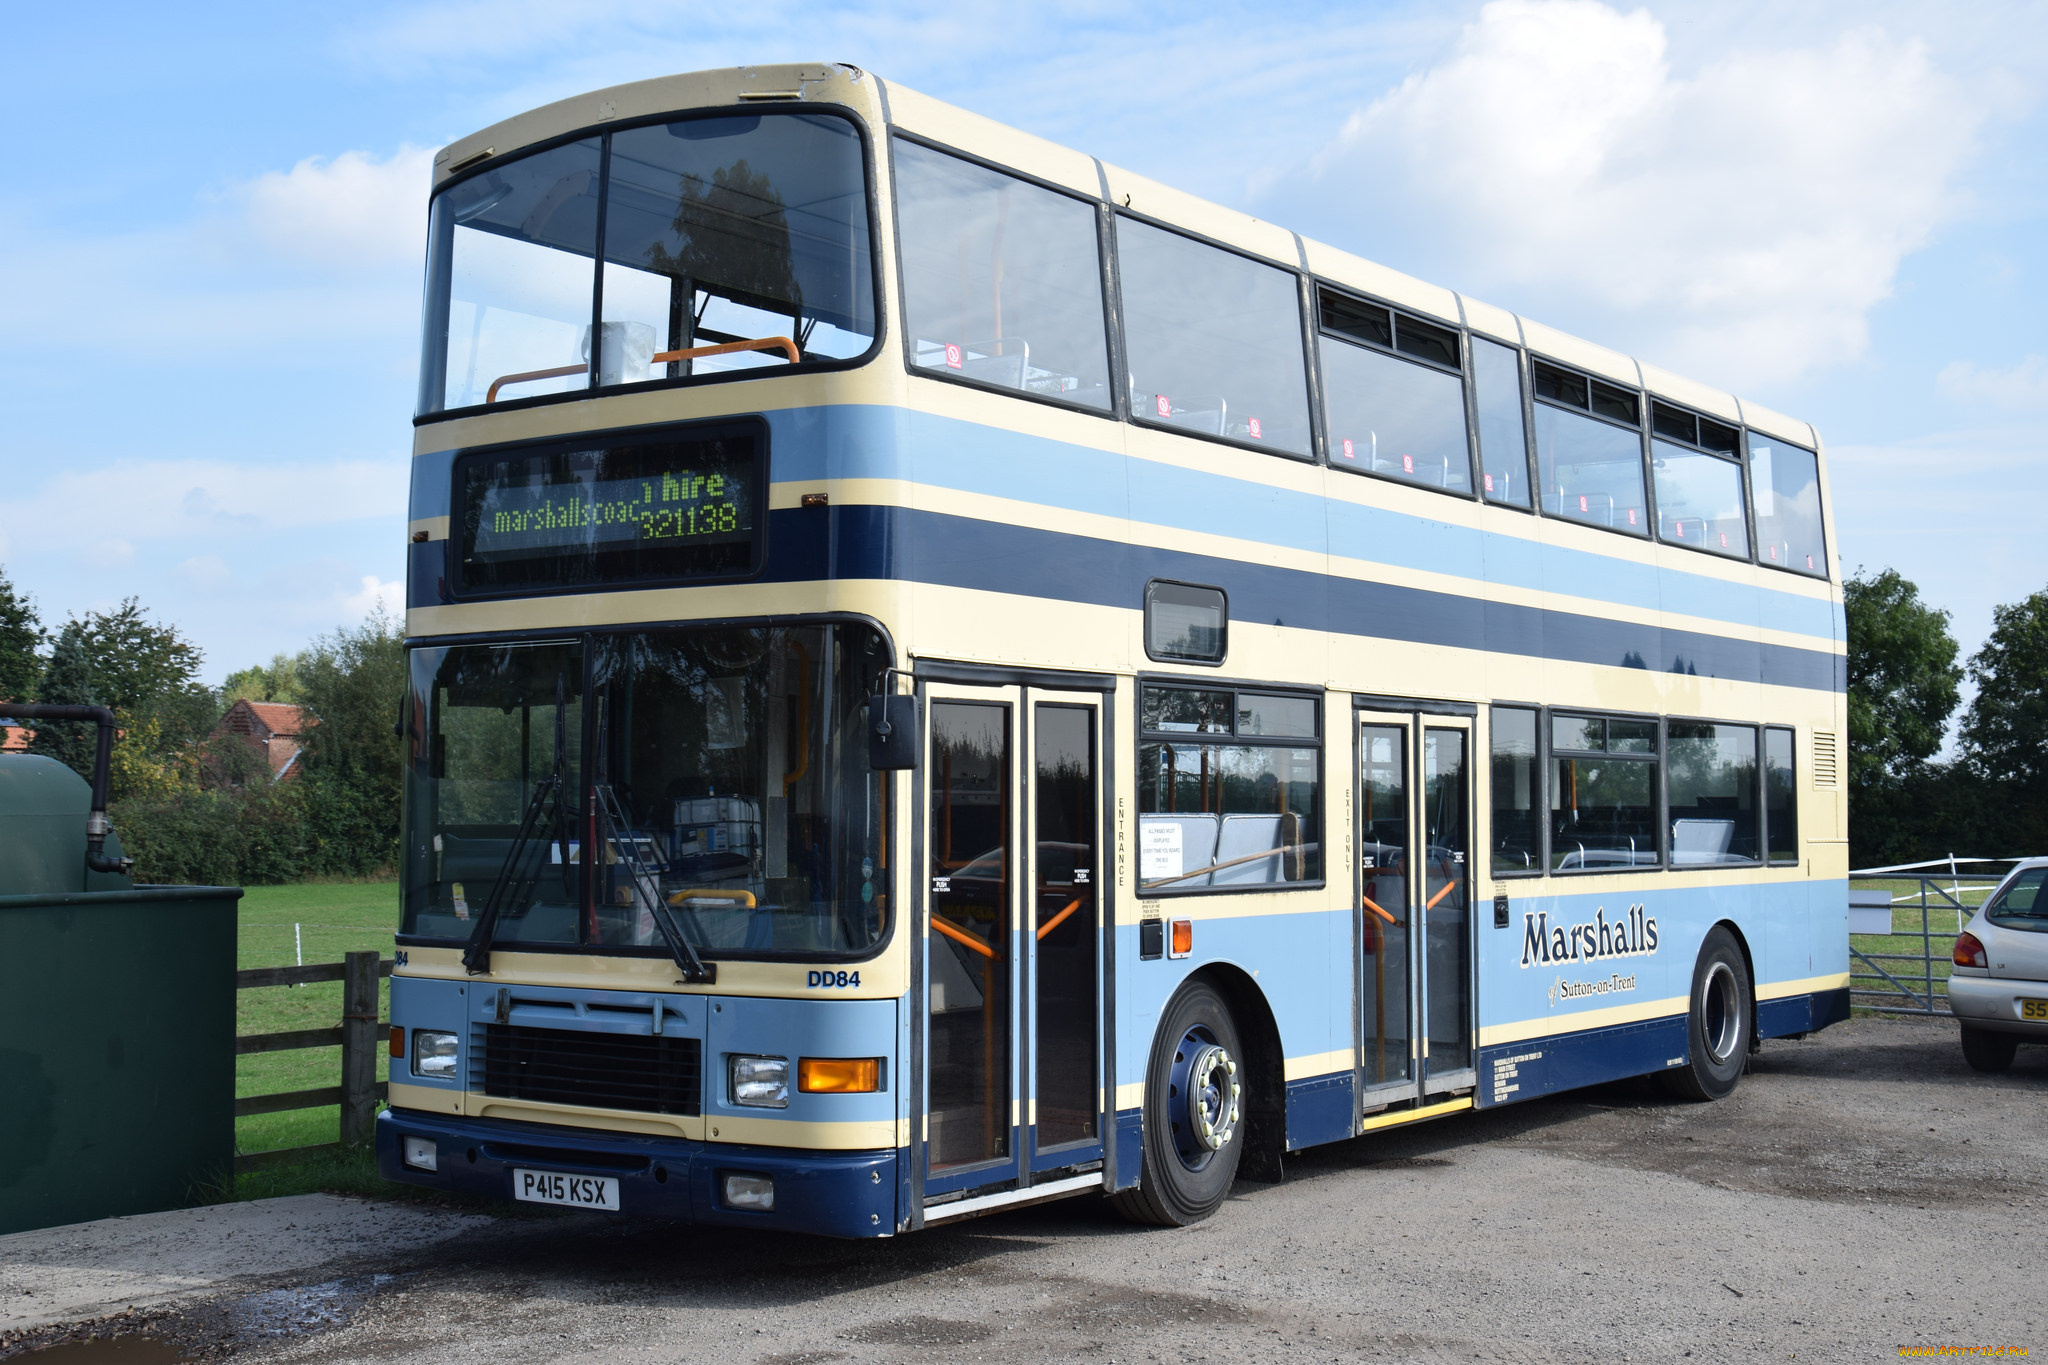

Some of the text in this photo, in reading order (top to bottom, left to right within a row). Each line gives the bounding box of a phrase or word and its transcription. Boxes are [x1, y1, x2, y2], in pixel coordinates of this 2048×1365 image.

[663, 469, 724, 502] hire
[1521, 903, 1659, 967] Marshalls
[807, 970, 861, 989] DD84
[1548, 974, 1636, 1007] of Sutton-on-Trent
[524, 1173, 606, 1205] P415 KSX
